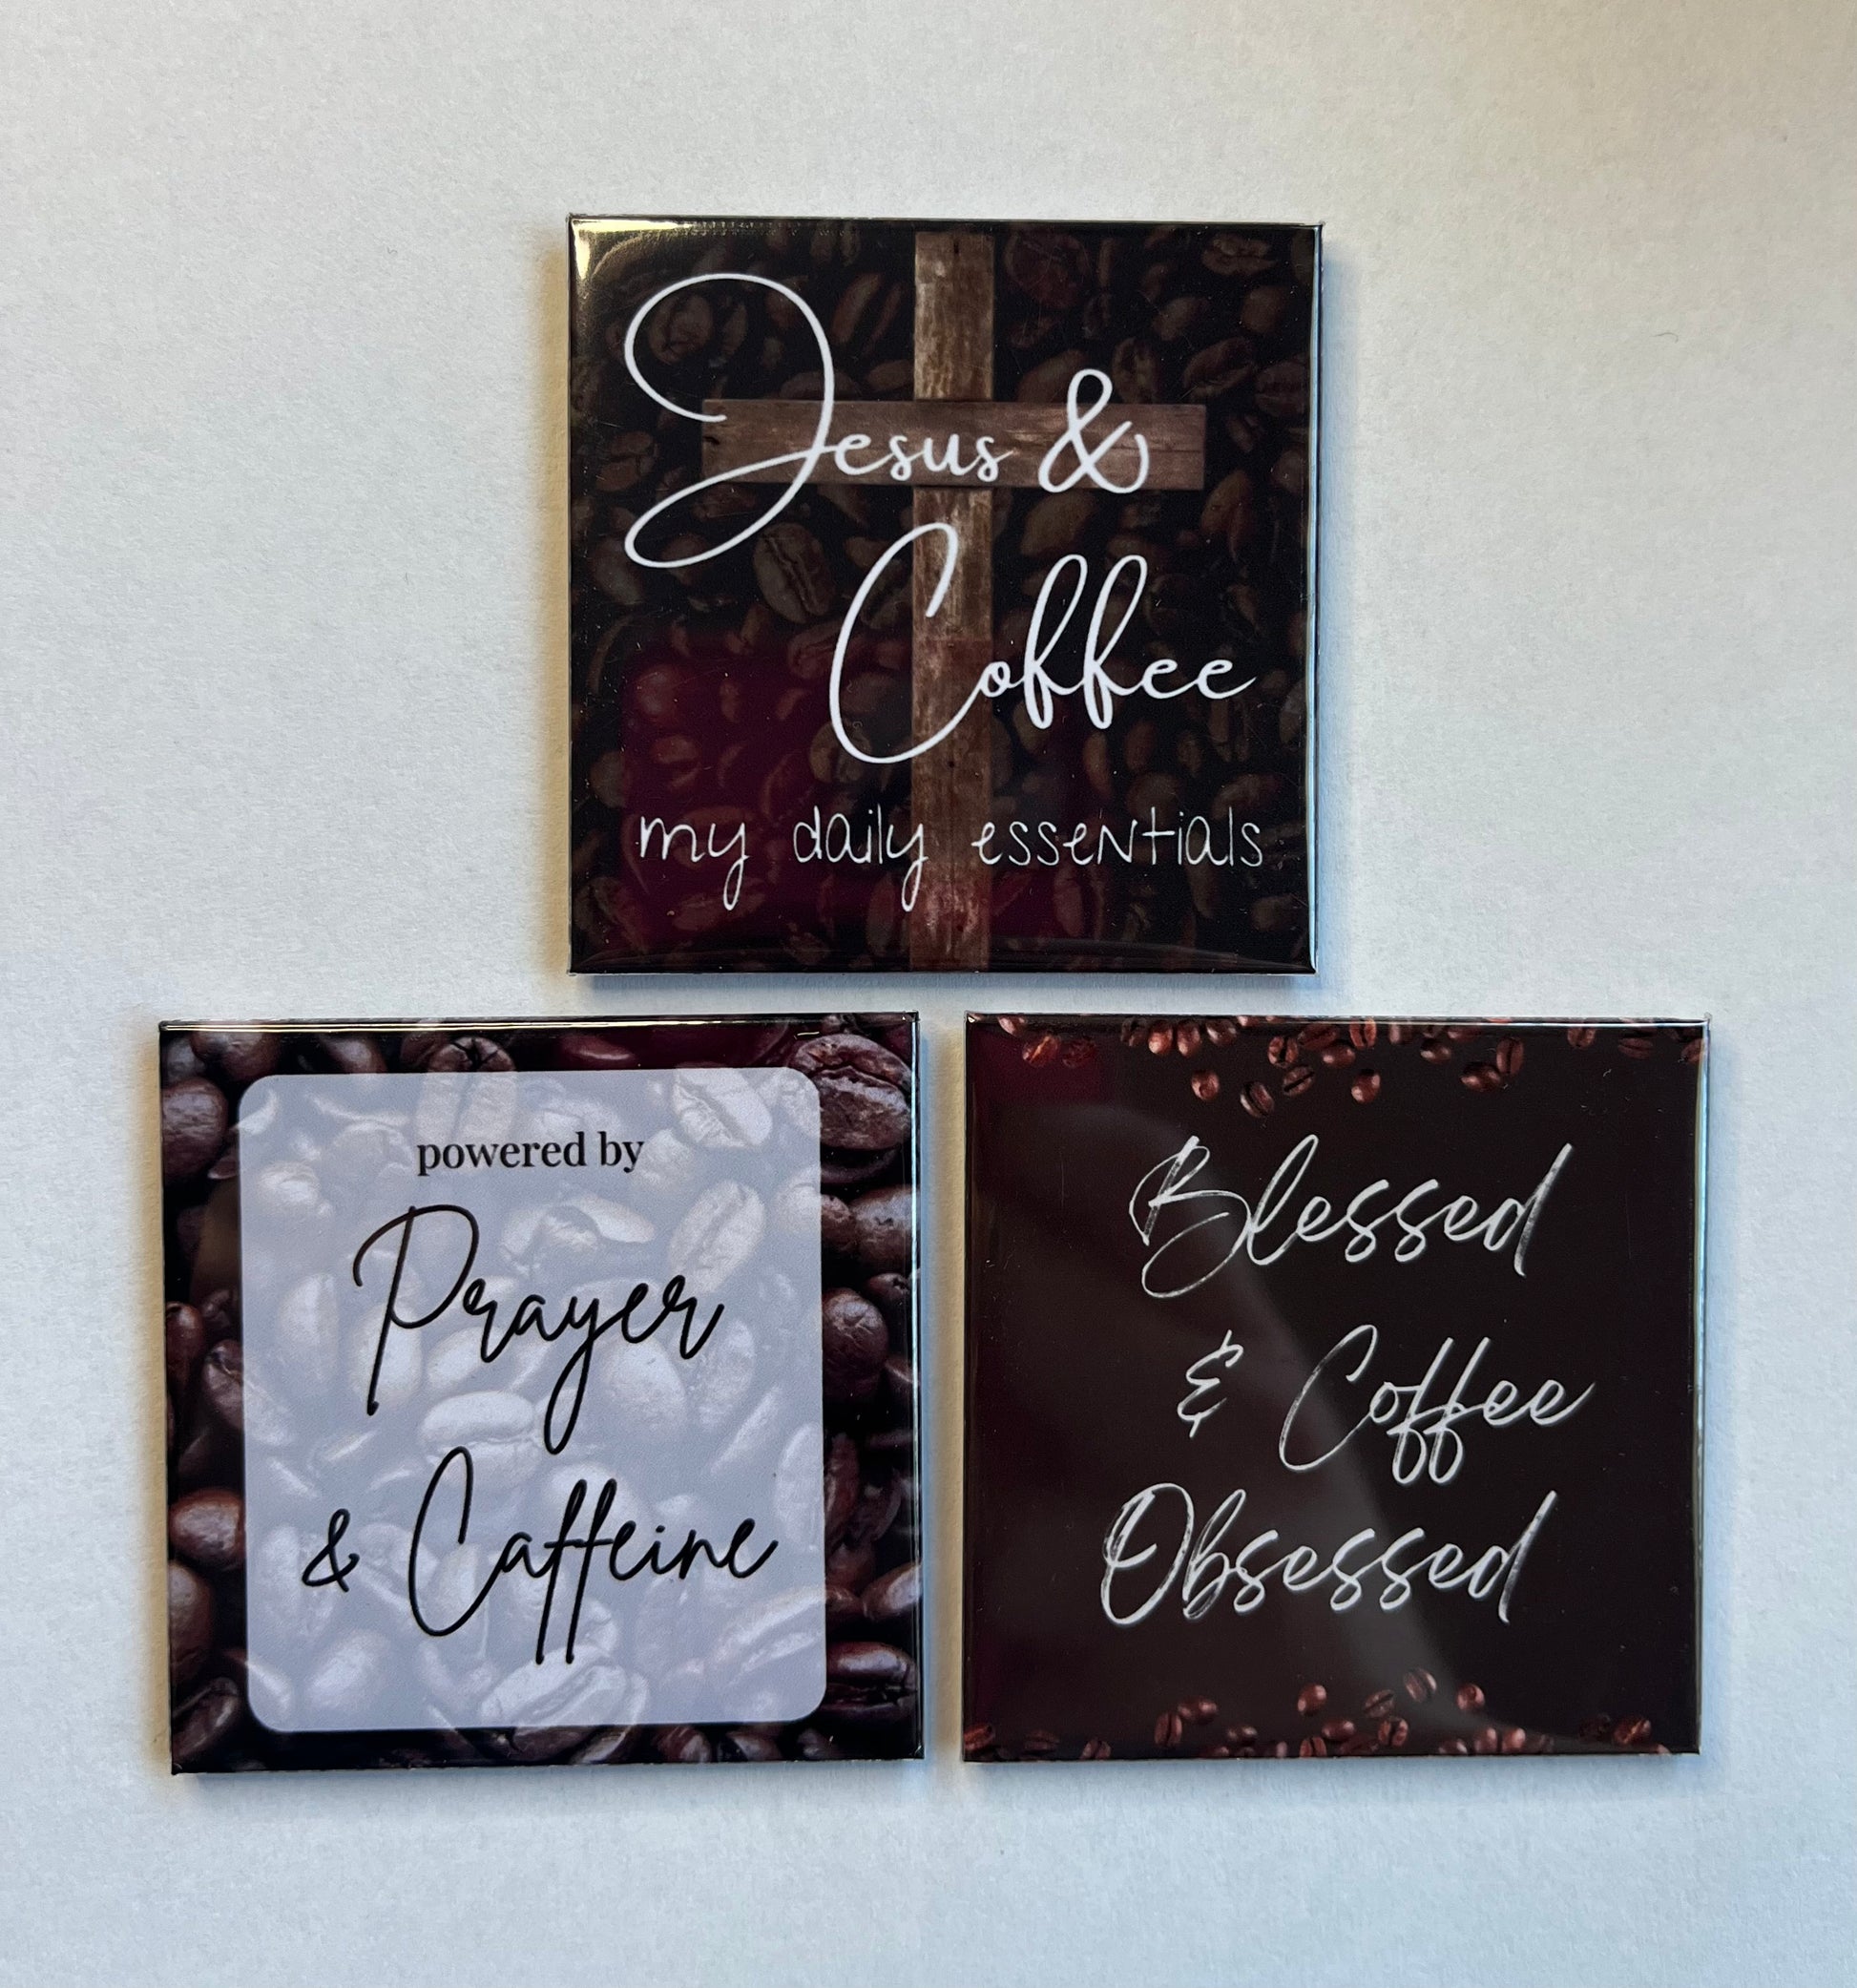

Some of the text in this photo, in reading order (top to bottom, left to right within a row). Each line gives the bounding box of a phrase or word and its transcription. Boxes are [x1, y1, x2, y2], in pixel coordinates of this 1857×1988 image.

[624, 272, 1150, 569] Jesus &
[828, 522, 1256, 764] Coffee
[637, 812, 748, 911] my
[793, 804, 928, 912] daily
[417, 1130, 644, 1176] powered by
[1129, 1134, 1574, 1299] Blessed
[352, 1203, 724, 1455] Prayer
[1177, 1324, 1596, 1485] & Coffee
[301, 1446, 779, 1664] & Caffeine
[1099, 1482, 1557, 1625] Obsessed
